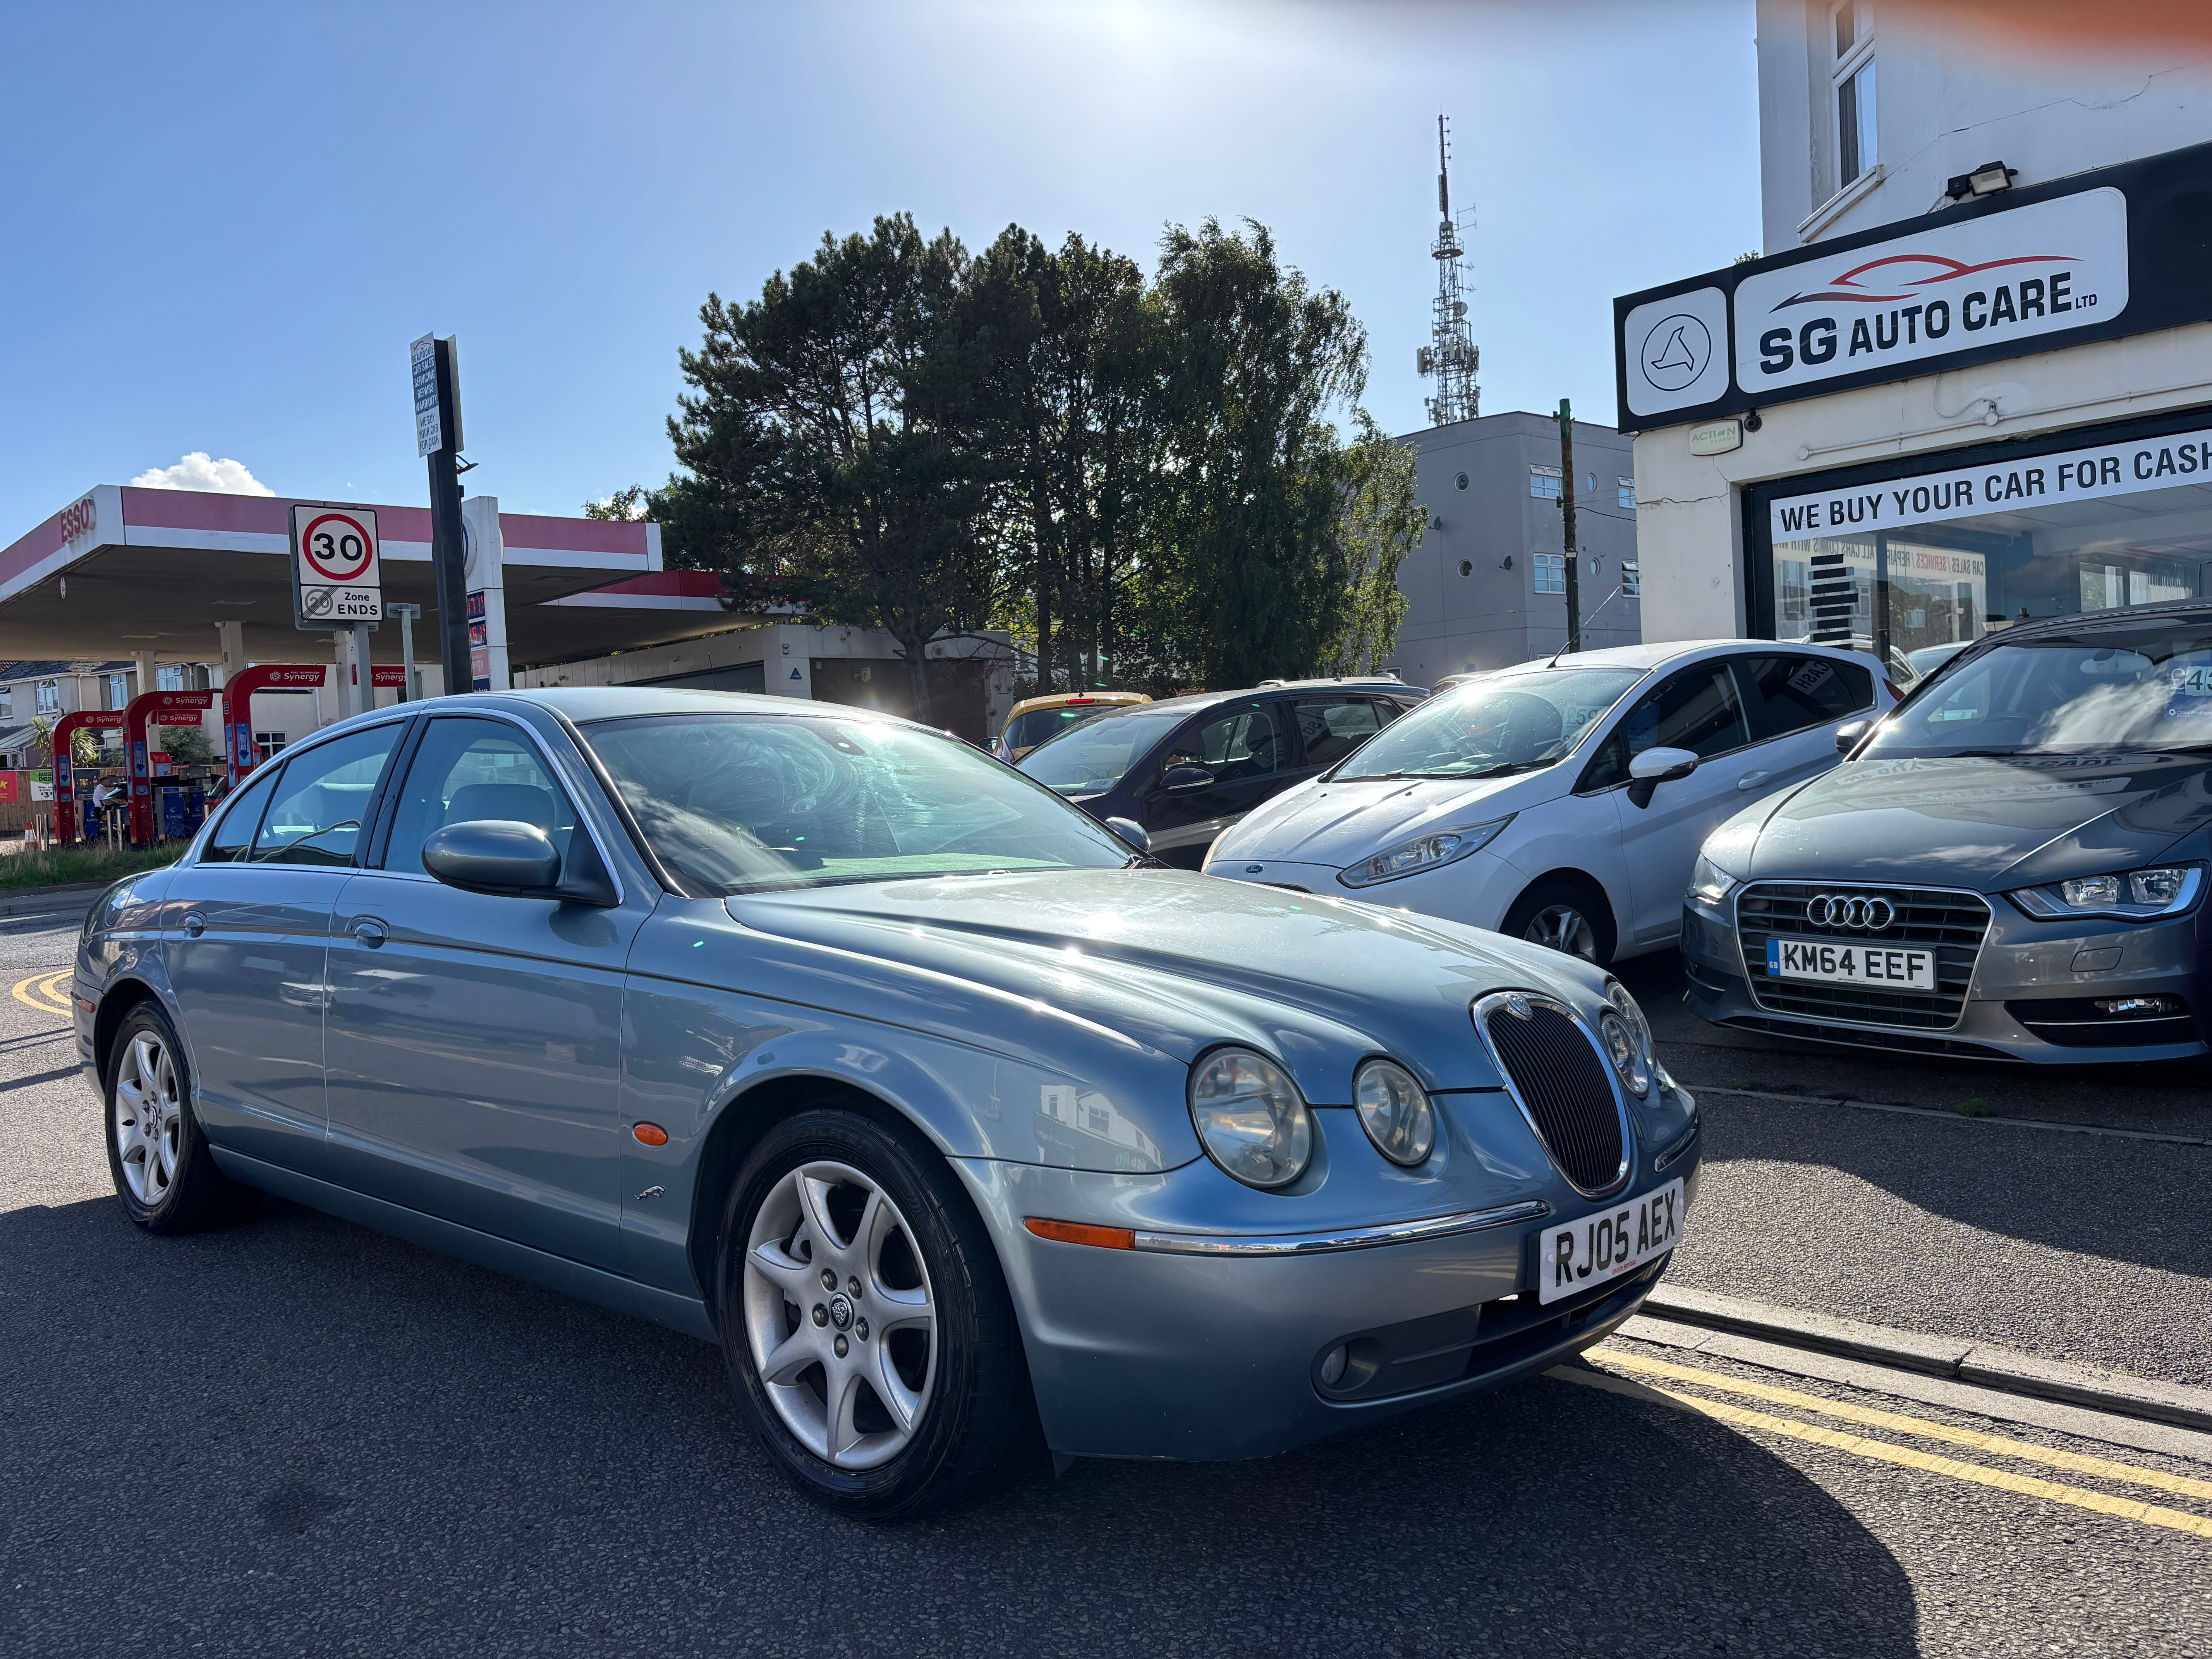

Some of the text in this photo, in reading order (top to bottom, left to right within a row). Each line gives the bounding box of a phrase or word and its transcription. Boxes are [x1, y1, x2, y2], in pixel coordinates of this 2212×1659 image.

[1759, 271, 2098, 375] SG AUTO CARE LTD
[412, 346, 433, 364] SG AUTO CARE
[413, 356, 434, 376] CAR SALES
[414, 369, 435, 388] SERVICING
[417, 383, 434, 399] REPAIRS
[415, 394, 437, 412] WARRANTY
[420, 413, 435, 427] WE BUY
[418, 423, 438, 440] YOUR CAR
[420, 434, 439, 451] FOR CASH
[1780, 503, 1820, 532] WE
[1829, 493, 1883, 526] BUY
[1893, 480, 1974, 515] YOUR
[1985, 468, 2045, 502] CAR
[2058, 456, 2121, 492] FOR
[60, 499, 89, 543] ESSO
[314, 533, 362, 561] 30
[345, 592, 370, 601] Zone
[338, 604, 378, 615] ENDS
[472, 661, 484, 671] ergy
[284, 673, 319, 681] Synergy
[2170, 668, 2212, 691] £4
[1784, 944, 1925, 980] KM64 EEF
[1556, 1188, 1675, 1288] RJ05 AEX
